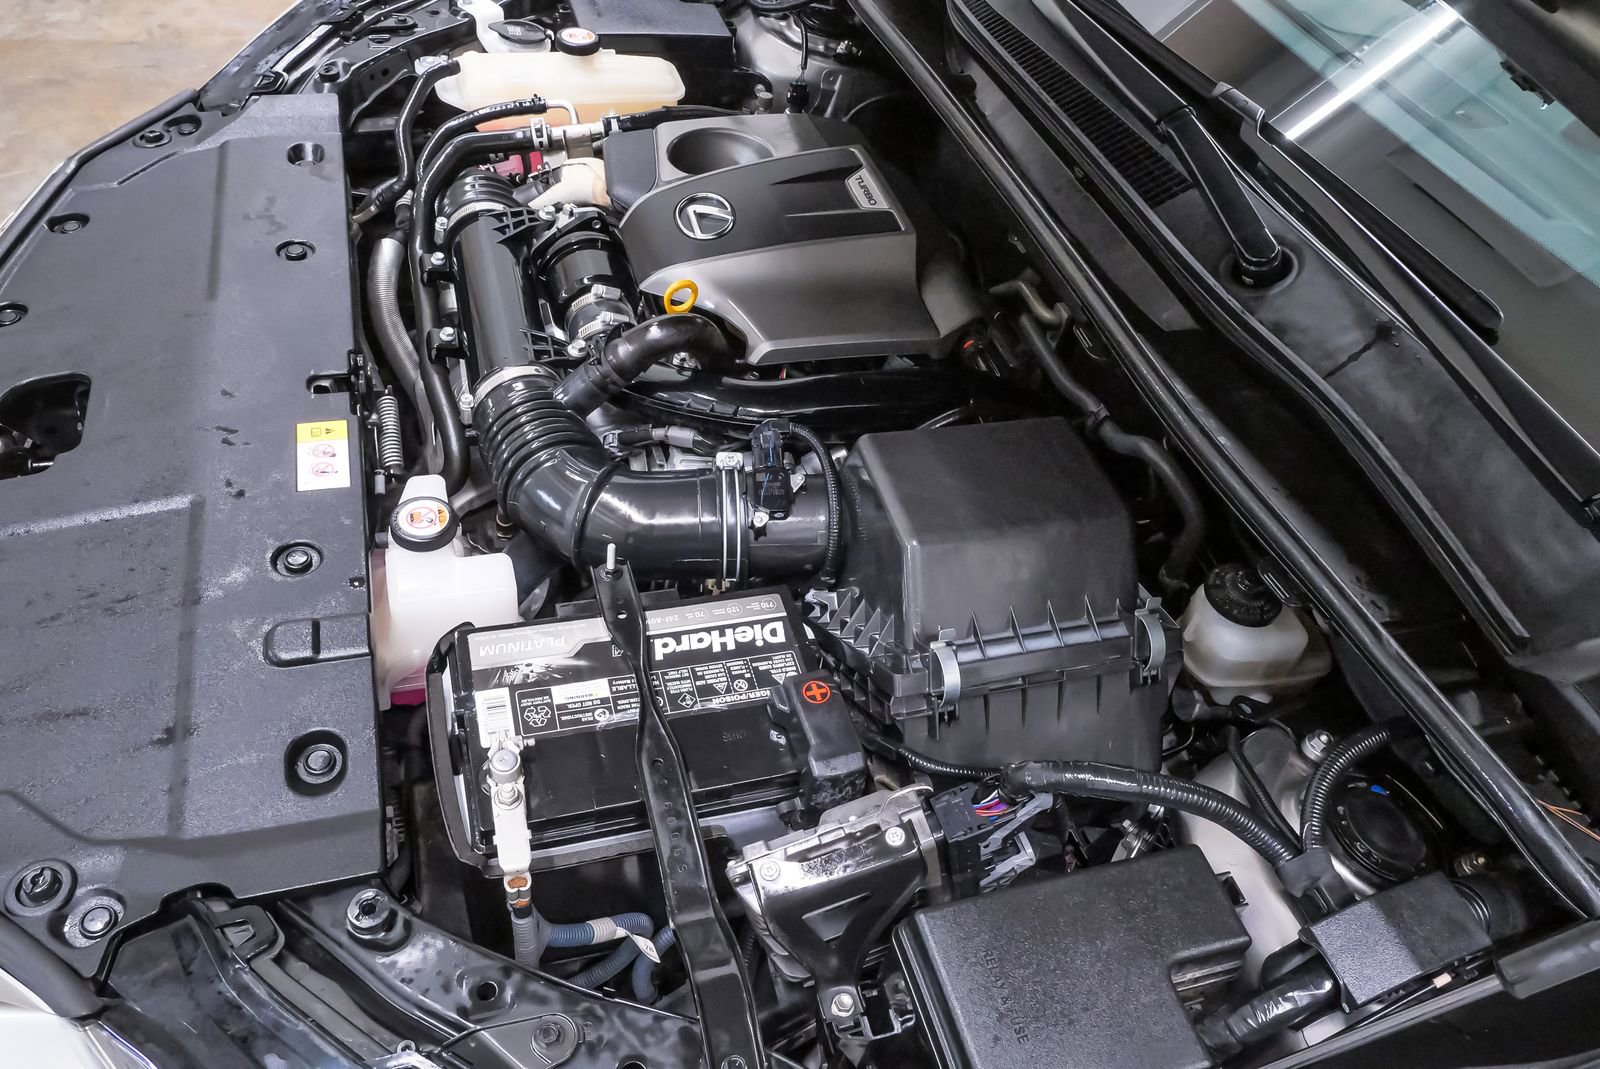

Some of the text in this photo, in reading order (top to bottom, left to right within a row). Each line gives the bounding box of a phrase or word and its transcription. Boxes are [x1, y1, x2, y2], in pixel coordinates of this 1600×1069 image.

[855, 175, 877, 206] TURBO
[726, 605, 740, 613] 120
[760, 601, 775, 609] 710
[479, 635, 565, 657] PLATINUM
[981, 949, 1030, 1045] RELAY & FUSE
